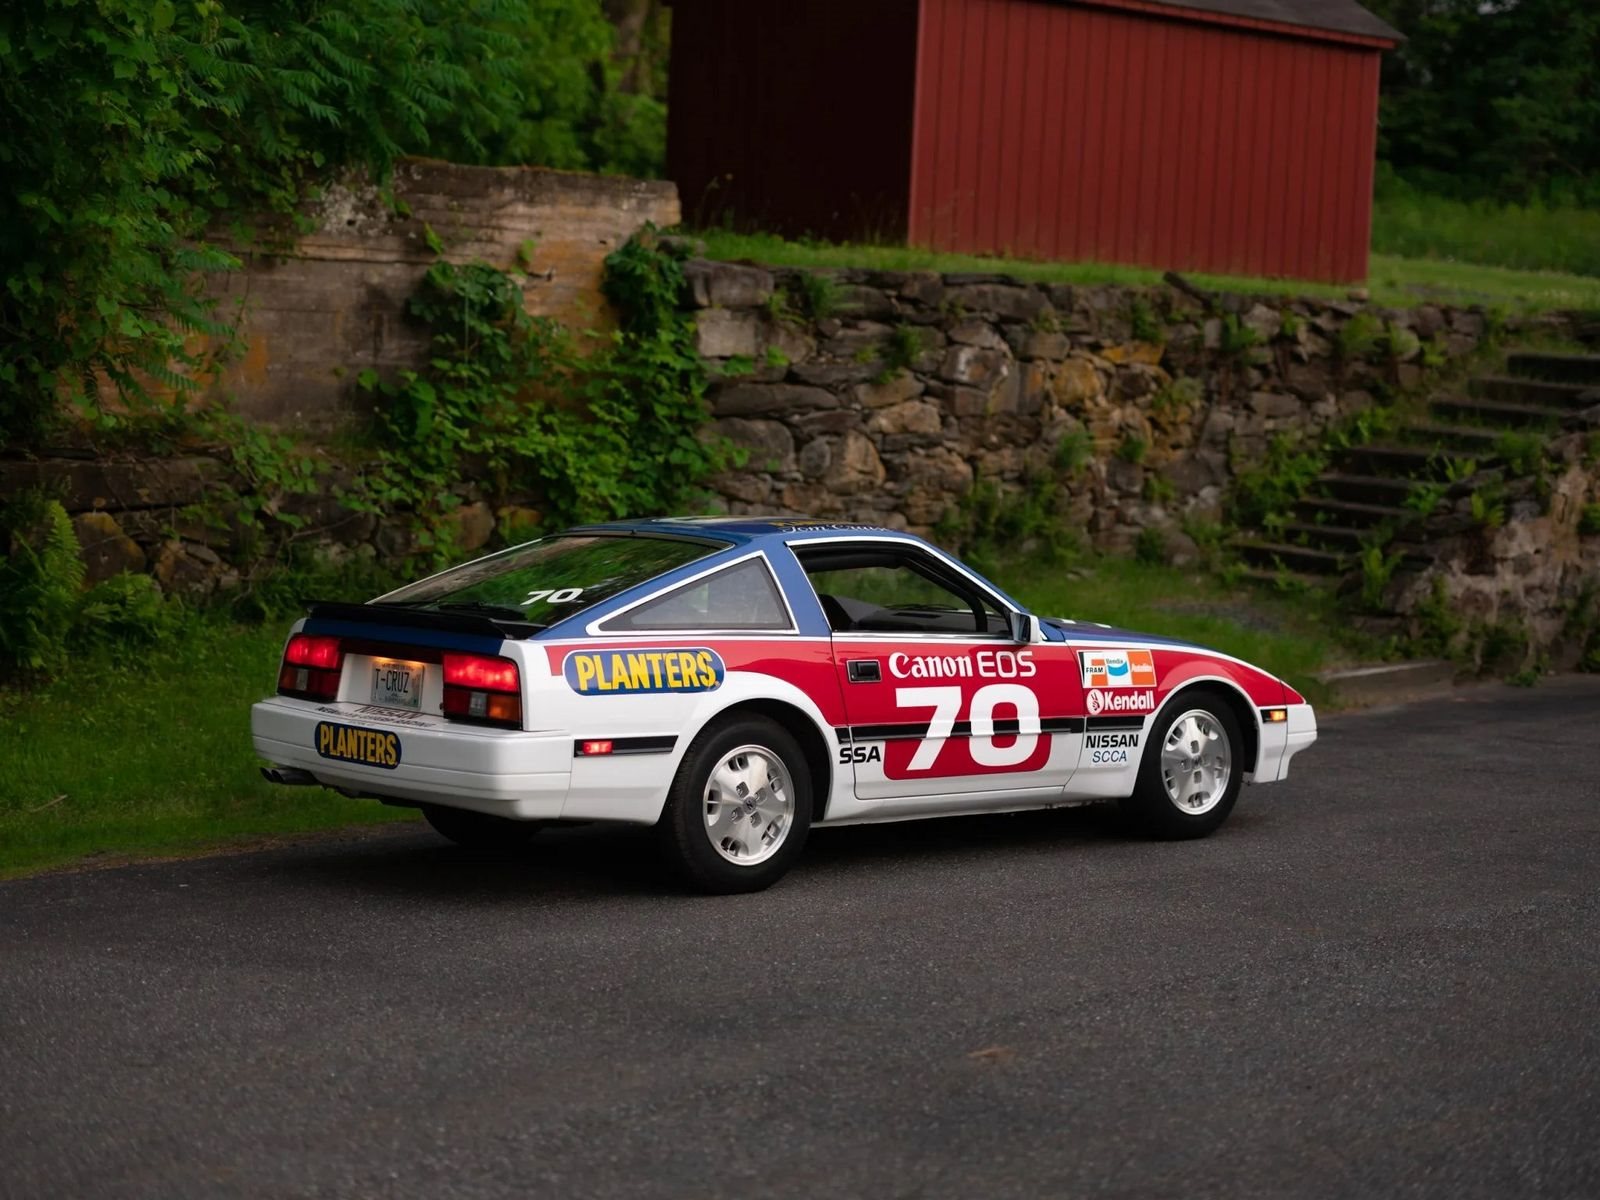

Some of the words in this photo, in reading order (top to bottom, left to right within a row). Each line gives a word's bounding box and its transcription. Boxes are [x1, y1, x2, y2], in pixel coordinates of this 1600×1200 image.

[520, 588, 585, 606] 70
[573, 651, 716, 691] PLANTERS
[888, 652, 973, 678] Canon
[976, 651, 1036, 678] EOS
[375, 668, 410, 693] T-CRUZ
[1104, 690, 1155, 711] Kendall
[895, 683, 1042, 771] 70
[319, 724, 398, 766] PLANTERS
[1085, 734, 1139, 748] NISSAN
[839, 746, 881, 765] SSA
[1092, 751, 1127, 763] SCCA
